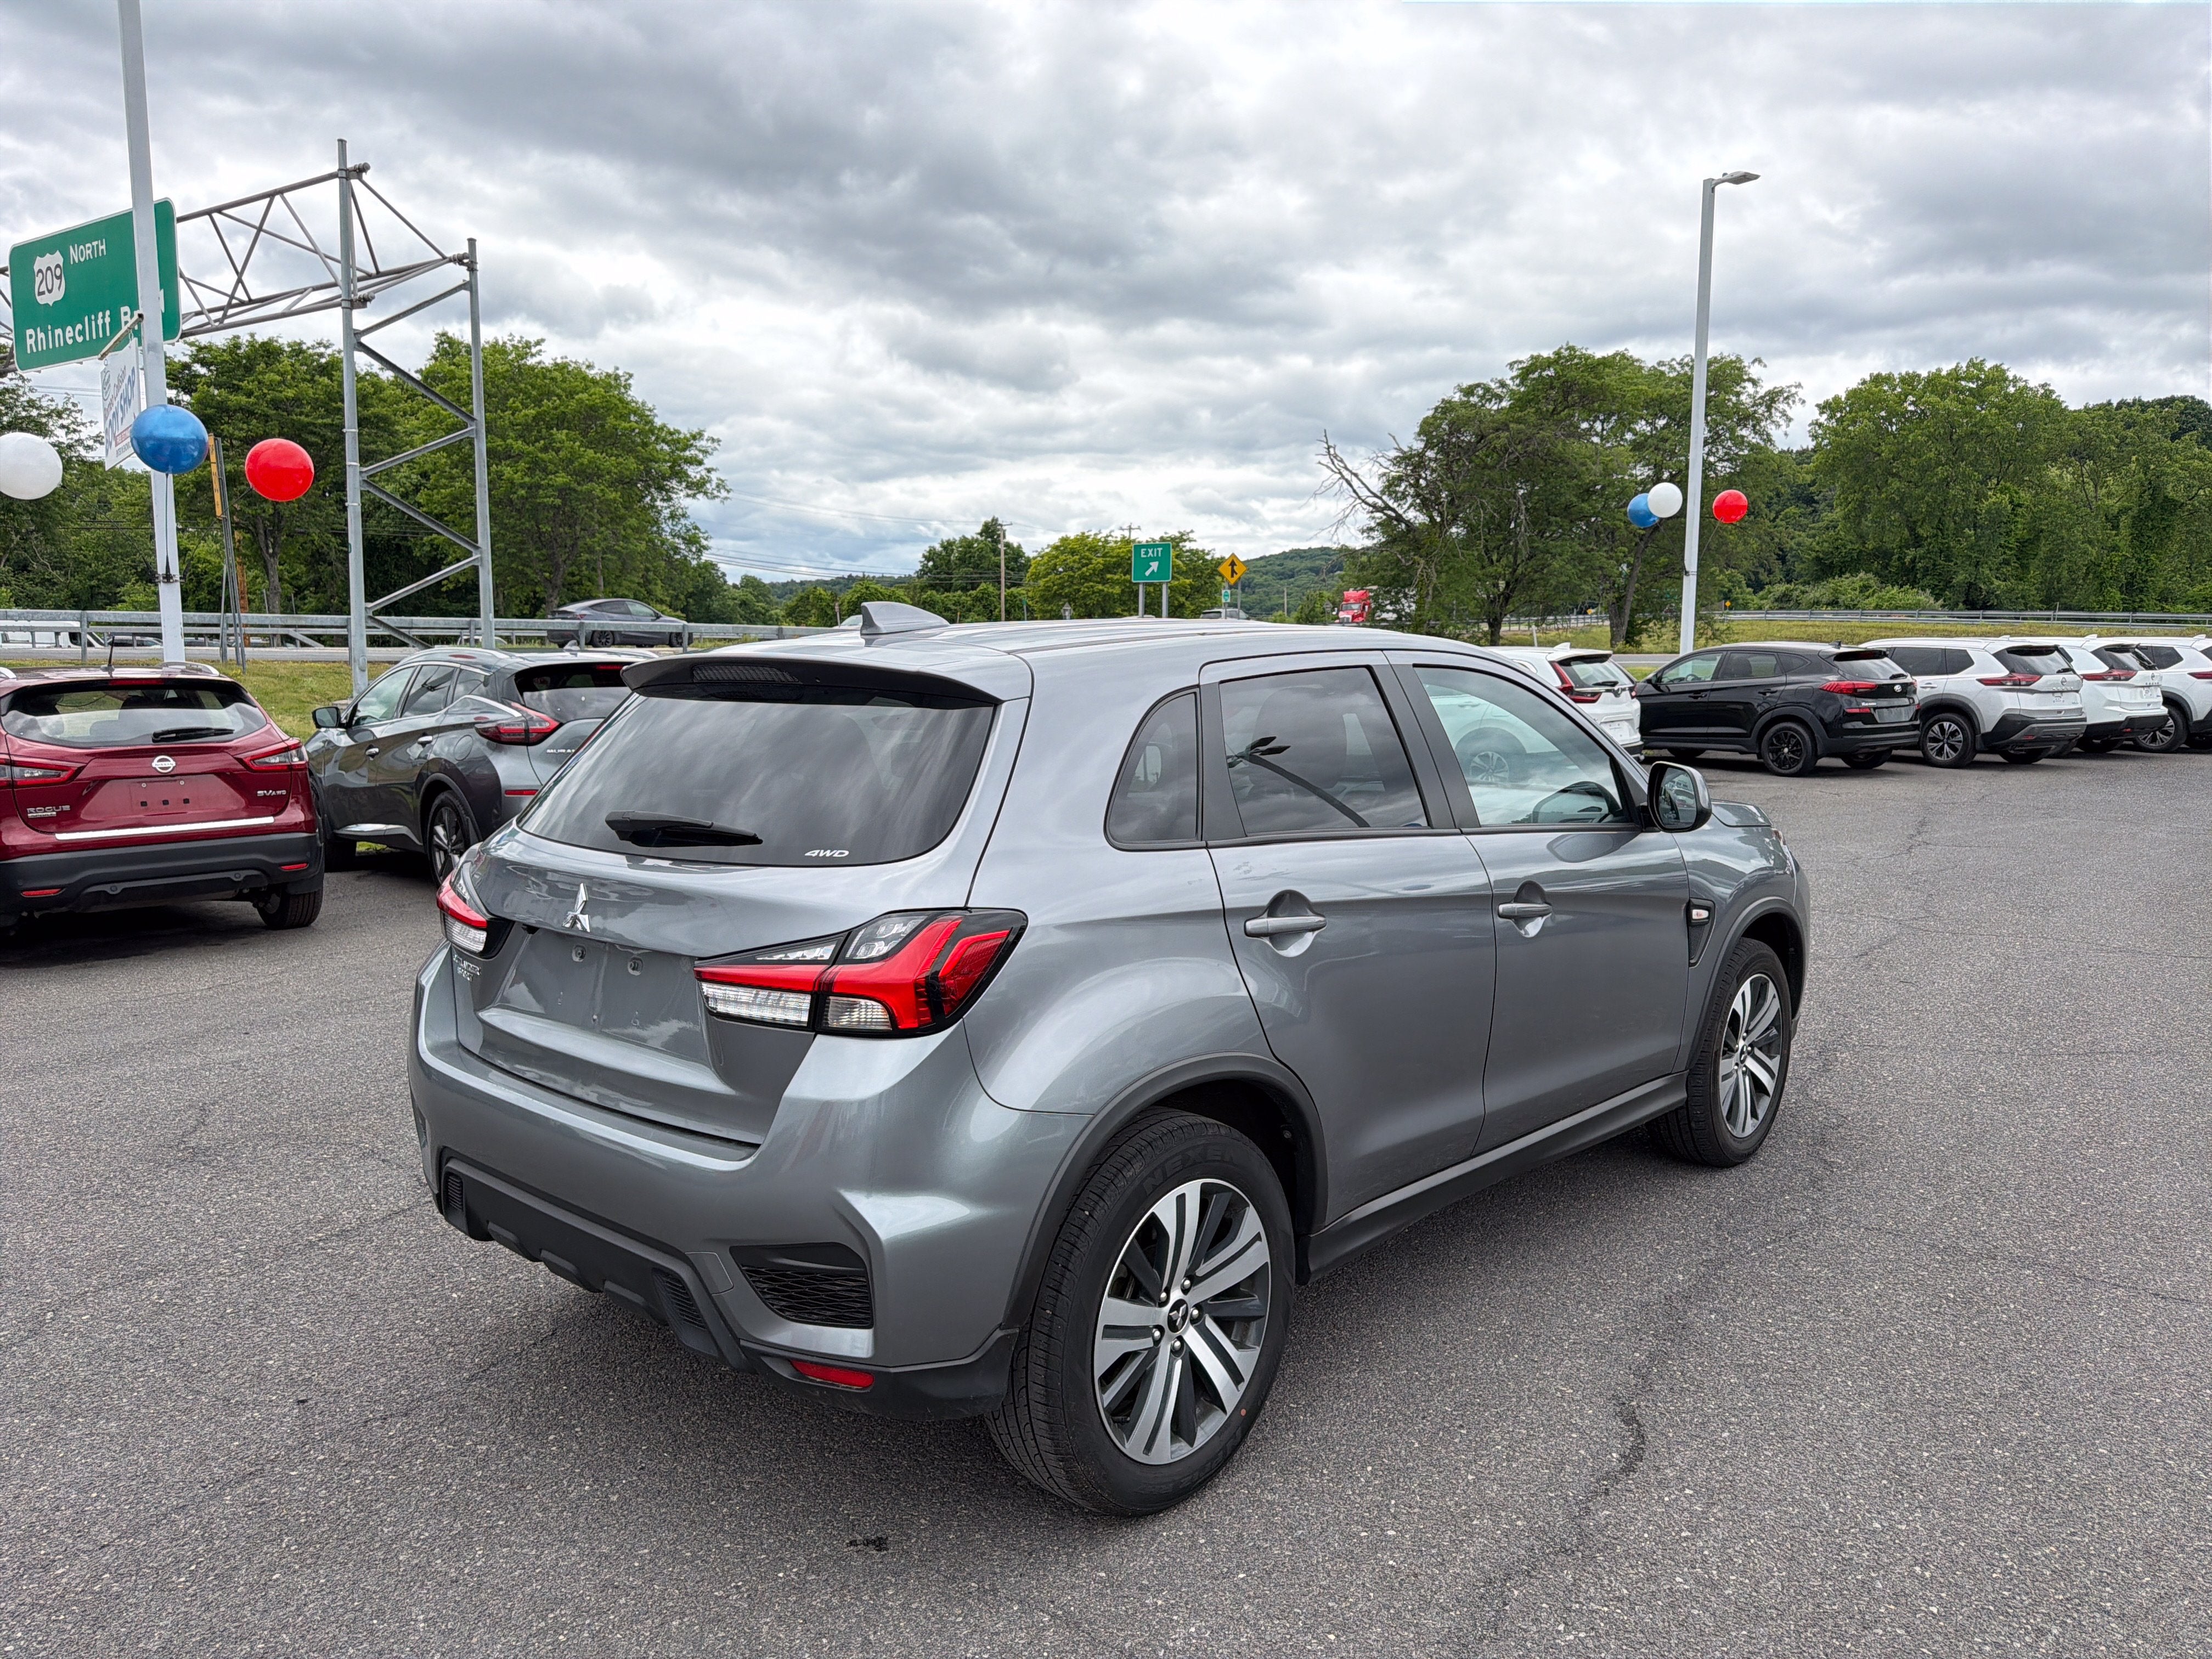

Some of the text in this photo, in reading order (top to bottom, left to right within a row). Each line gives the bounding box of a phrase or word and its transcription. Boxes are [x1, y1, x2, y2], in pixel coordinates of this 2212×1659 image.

[70, 238, 106, 265] NORTH
[36, 263, 63, 297] 209
[26, 310, 111, 354] Rhinecliff
[105, 400, 119, 458] BODY
[120, 366, 136, 426] SHOP
[1141, 548, 1163, 558] EXIT
[26, 805, 71, 813] ROGUE
[804, 849, 849, 857] 4WD
